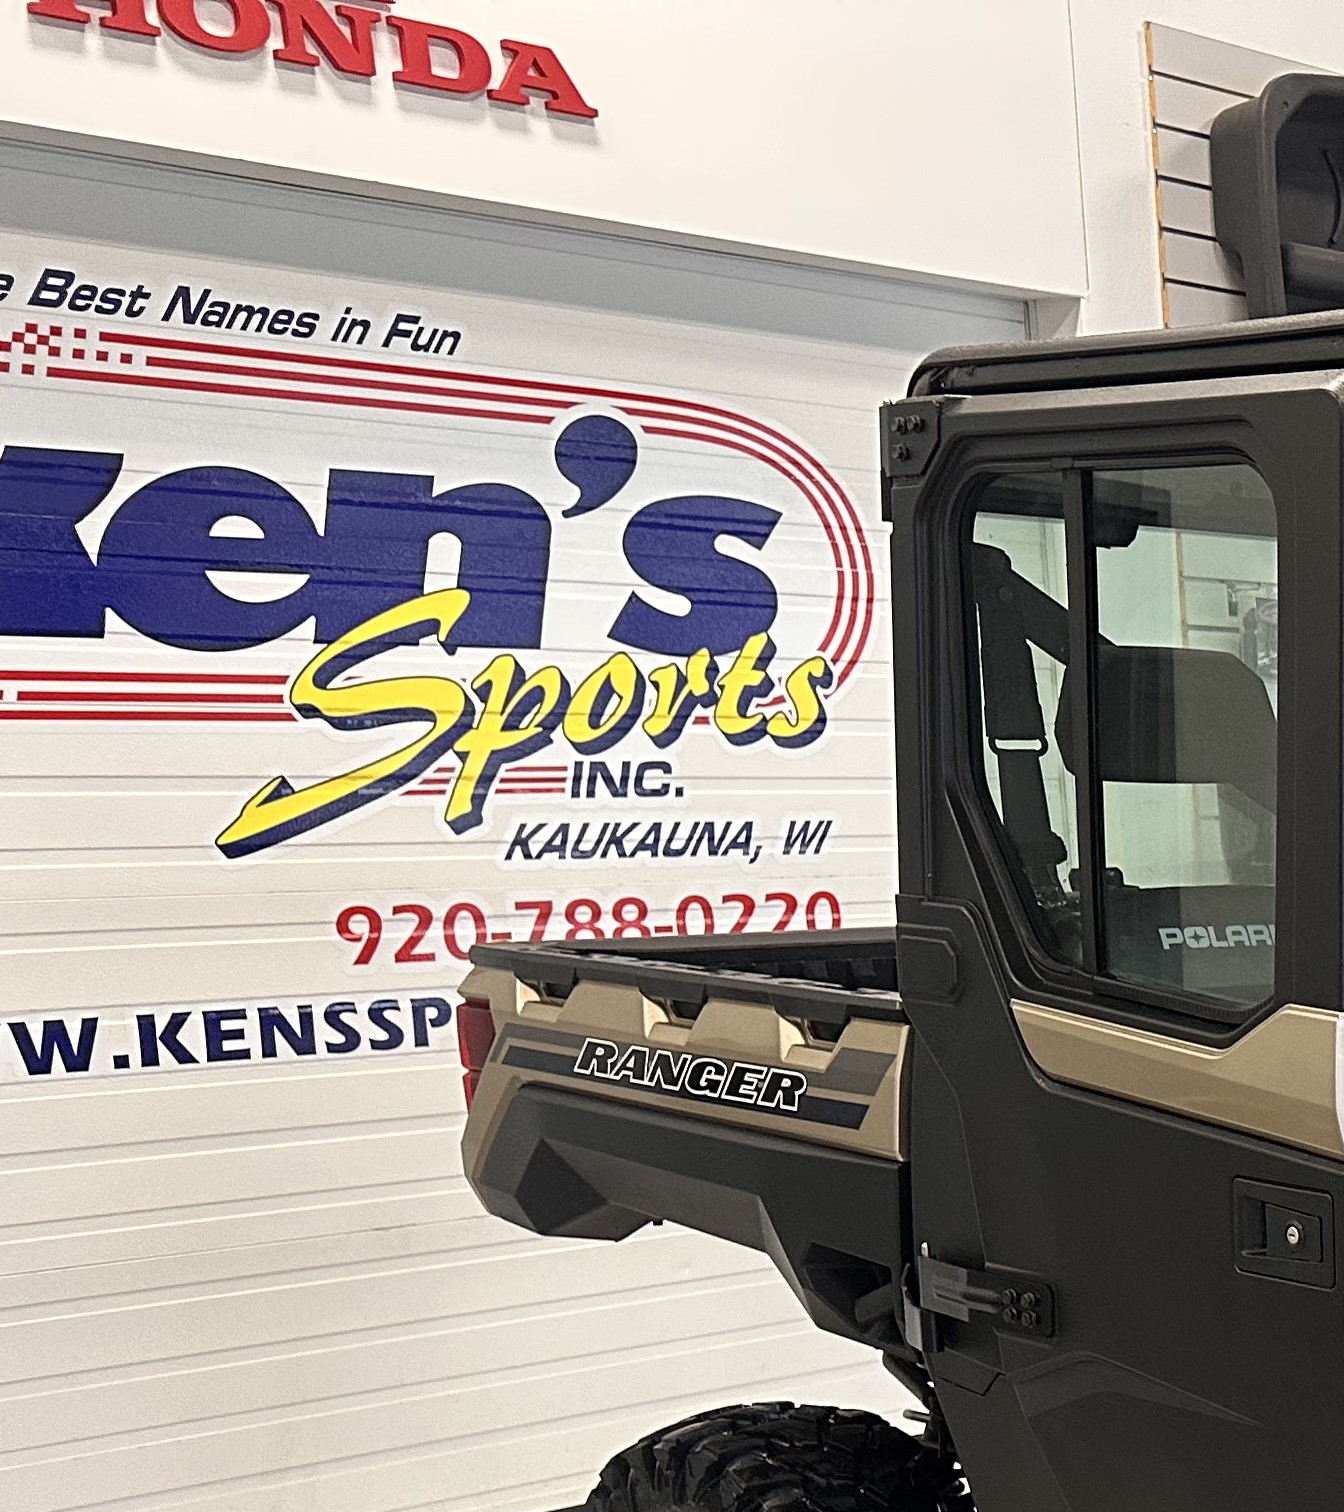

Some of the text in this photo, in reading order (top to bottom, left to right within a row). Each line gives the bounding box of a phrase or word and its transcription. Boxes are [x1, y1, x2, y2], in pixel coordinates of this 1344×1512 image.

[27, 267, 152, 318] Best
[161, 285, 320, 338] Names
[330, 307, 374, 345] in
[381, 313, 463, 356] Fun
[214, 588, 834, 859] Sports
[570, 760, 685, 799] INC.
[504, 819, 834, 865] KAUKAUNA, WI
[335, 890, 842, 966] 920-788-0220
[1158, 923, 1276, 950] POLARI
[573, 1036, 808, 1112] RANGER
